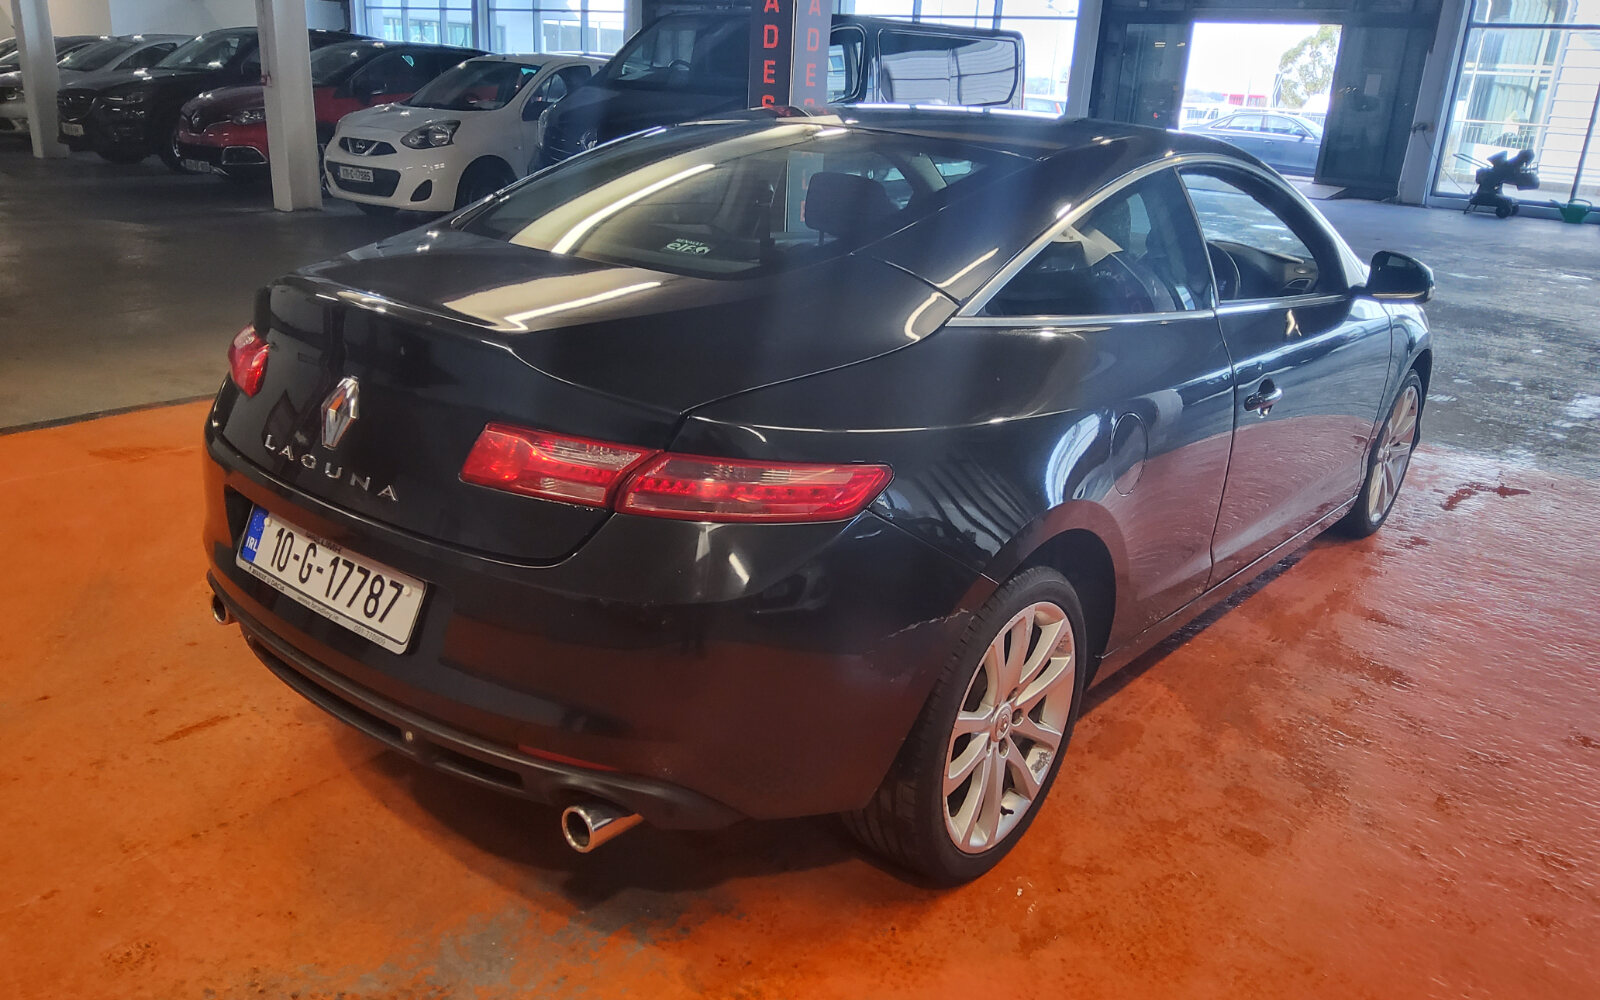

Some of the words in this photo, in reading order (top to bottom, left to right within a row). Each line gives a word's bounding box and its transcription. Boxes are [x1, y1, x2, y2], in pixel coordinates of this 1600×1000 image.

[264, 434, 399, 501] LAGUNA
[246, 536, 259, 552] IRL
[270, 527, 405, 623] 10-G-17787
